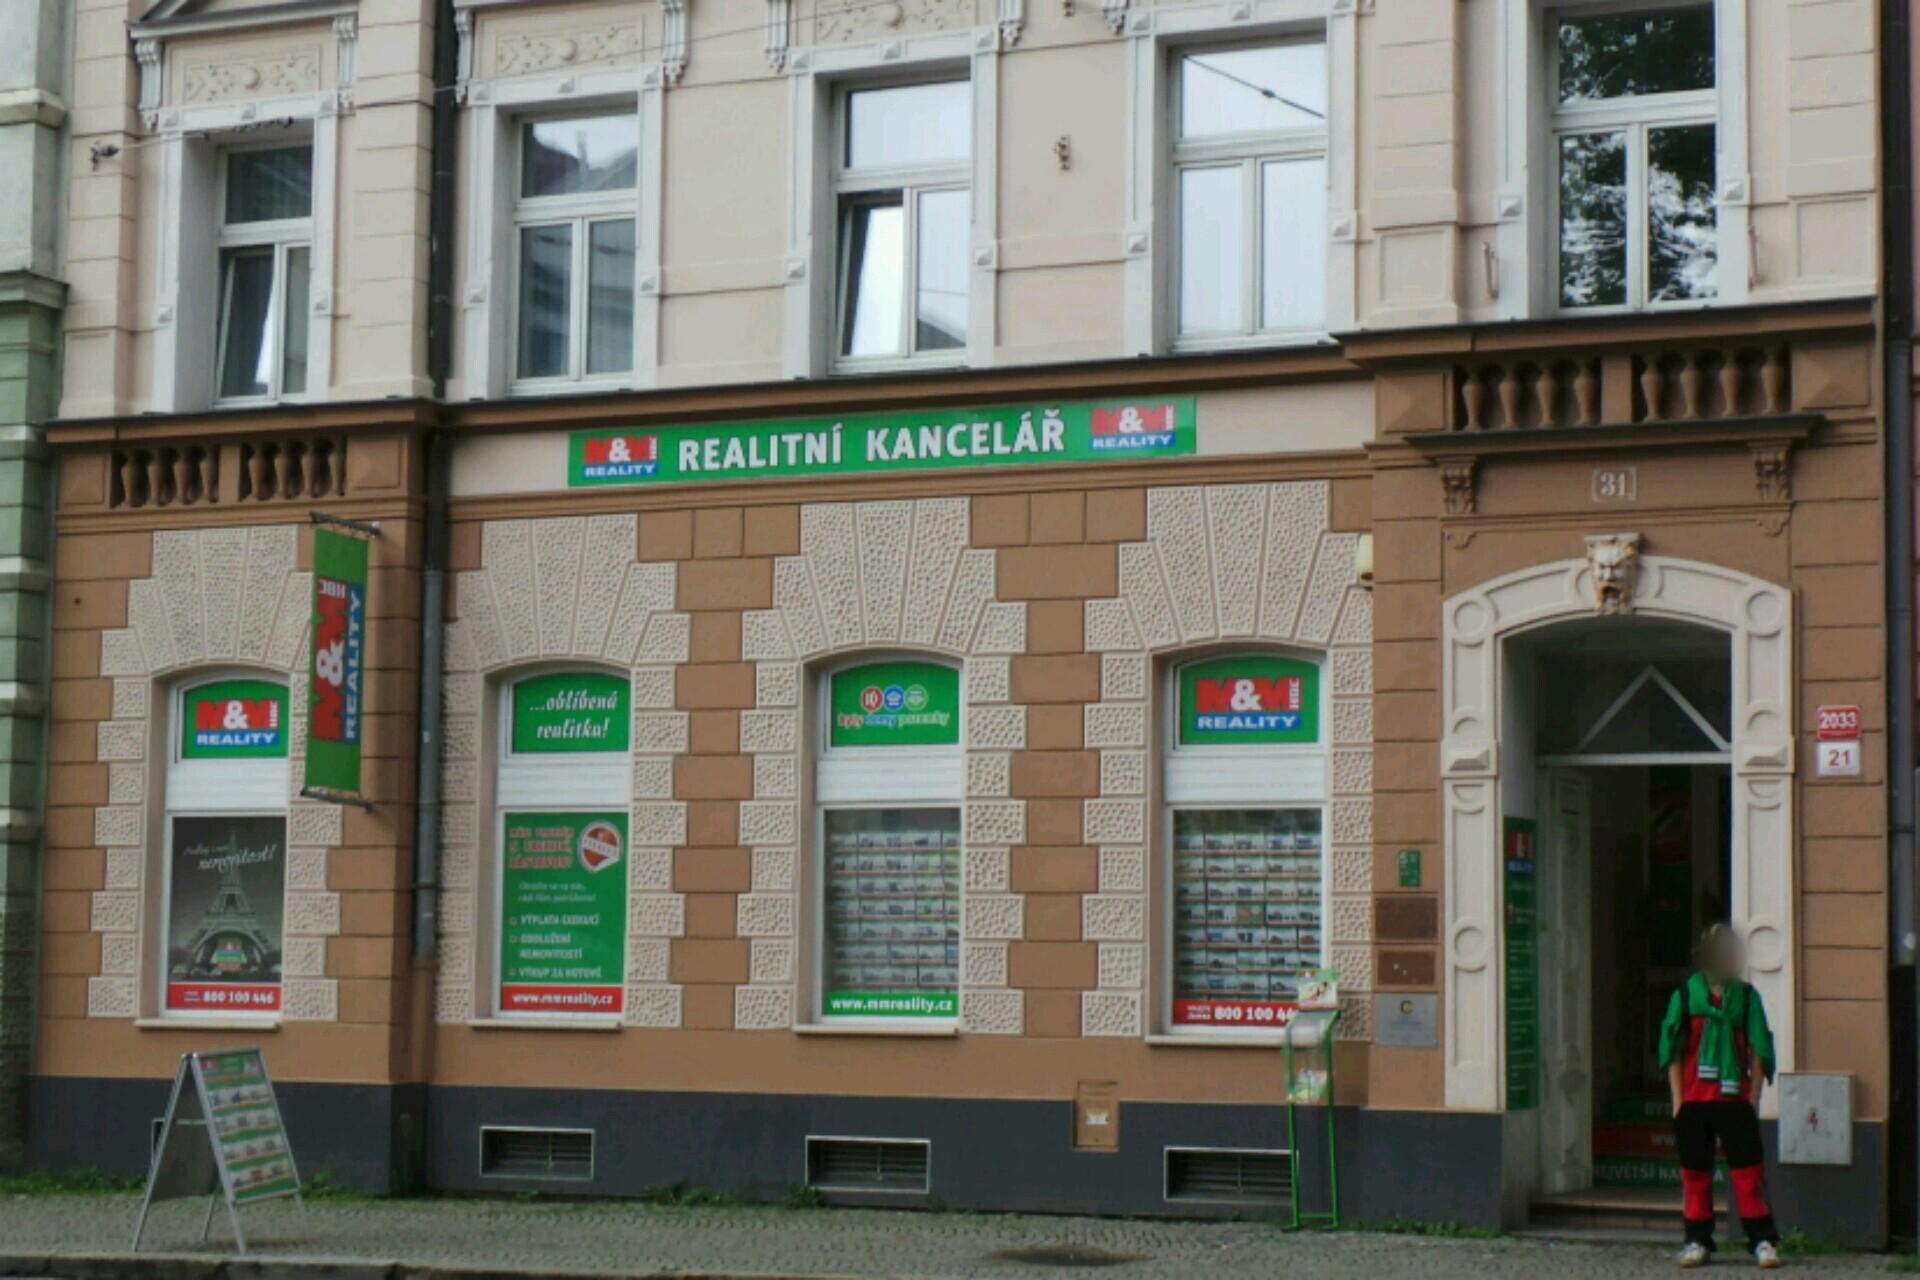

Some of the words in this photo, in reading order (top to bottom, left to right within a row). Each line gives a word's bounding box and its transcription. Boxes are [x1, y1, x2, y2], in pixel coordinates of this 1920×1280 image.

[1092, 404, 1165, 435] M&M
[585, 435, 649, 464] M&M
[679, 423, 842, 472] REALITNÍ
[867, 408, 1065, 462] KANCELÁŘ
[1093, 434, 1172, 449] REALITY
[585, 464, 655, 477] REALITY
[1600, 471, 1626, 497] 31
[312, 592, 345, 740] M&M
[345, 589, 361, 740] REALITY
[530, 688, 618, 711] ...oblíbená
[1196, 677, 1289, 712] M&M
[197, 699, 269, 730] M&M
[1198, 715, 1297, 730] REALITY
[197, 732, 276, 746] REALITY
[537, 717, 611, 739] realitka!
[1828, 749, 1850, 767] 21
[229, 991, 250, 1003] 100
[511, 991, 614, 1007] www.mmreality.cz
[830, 996, 953, 1014] www.mmreality.cz
[1214, 1005, 1242, 1020] 800
[1246, 1006, 1274, 1020] 100
